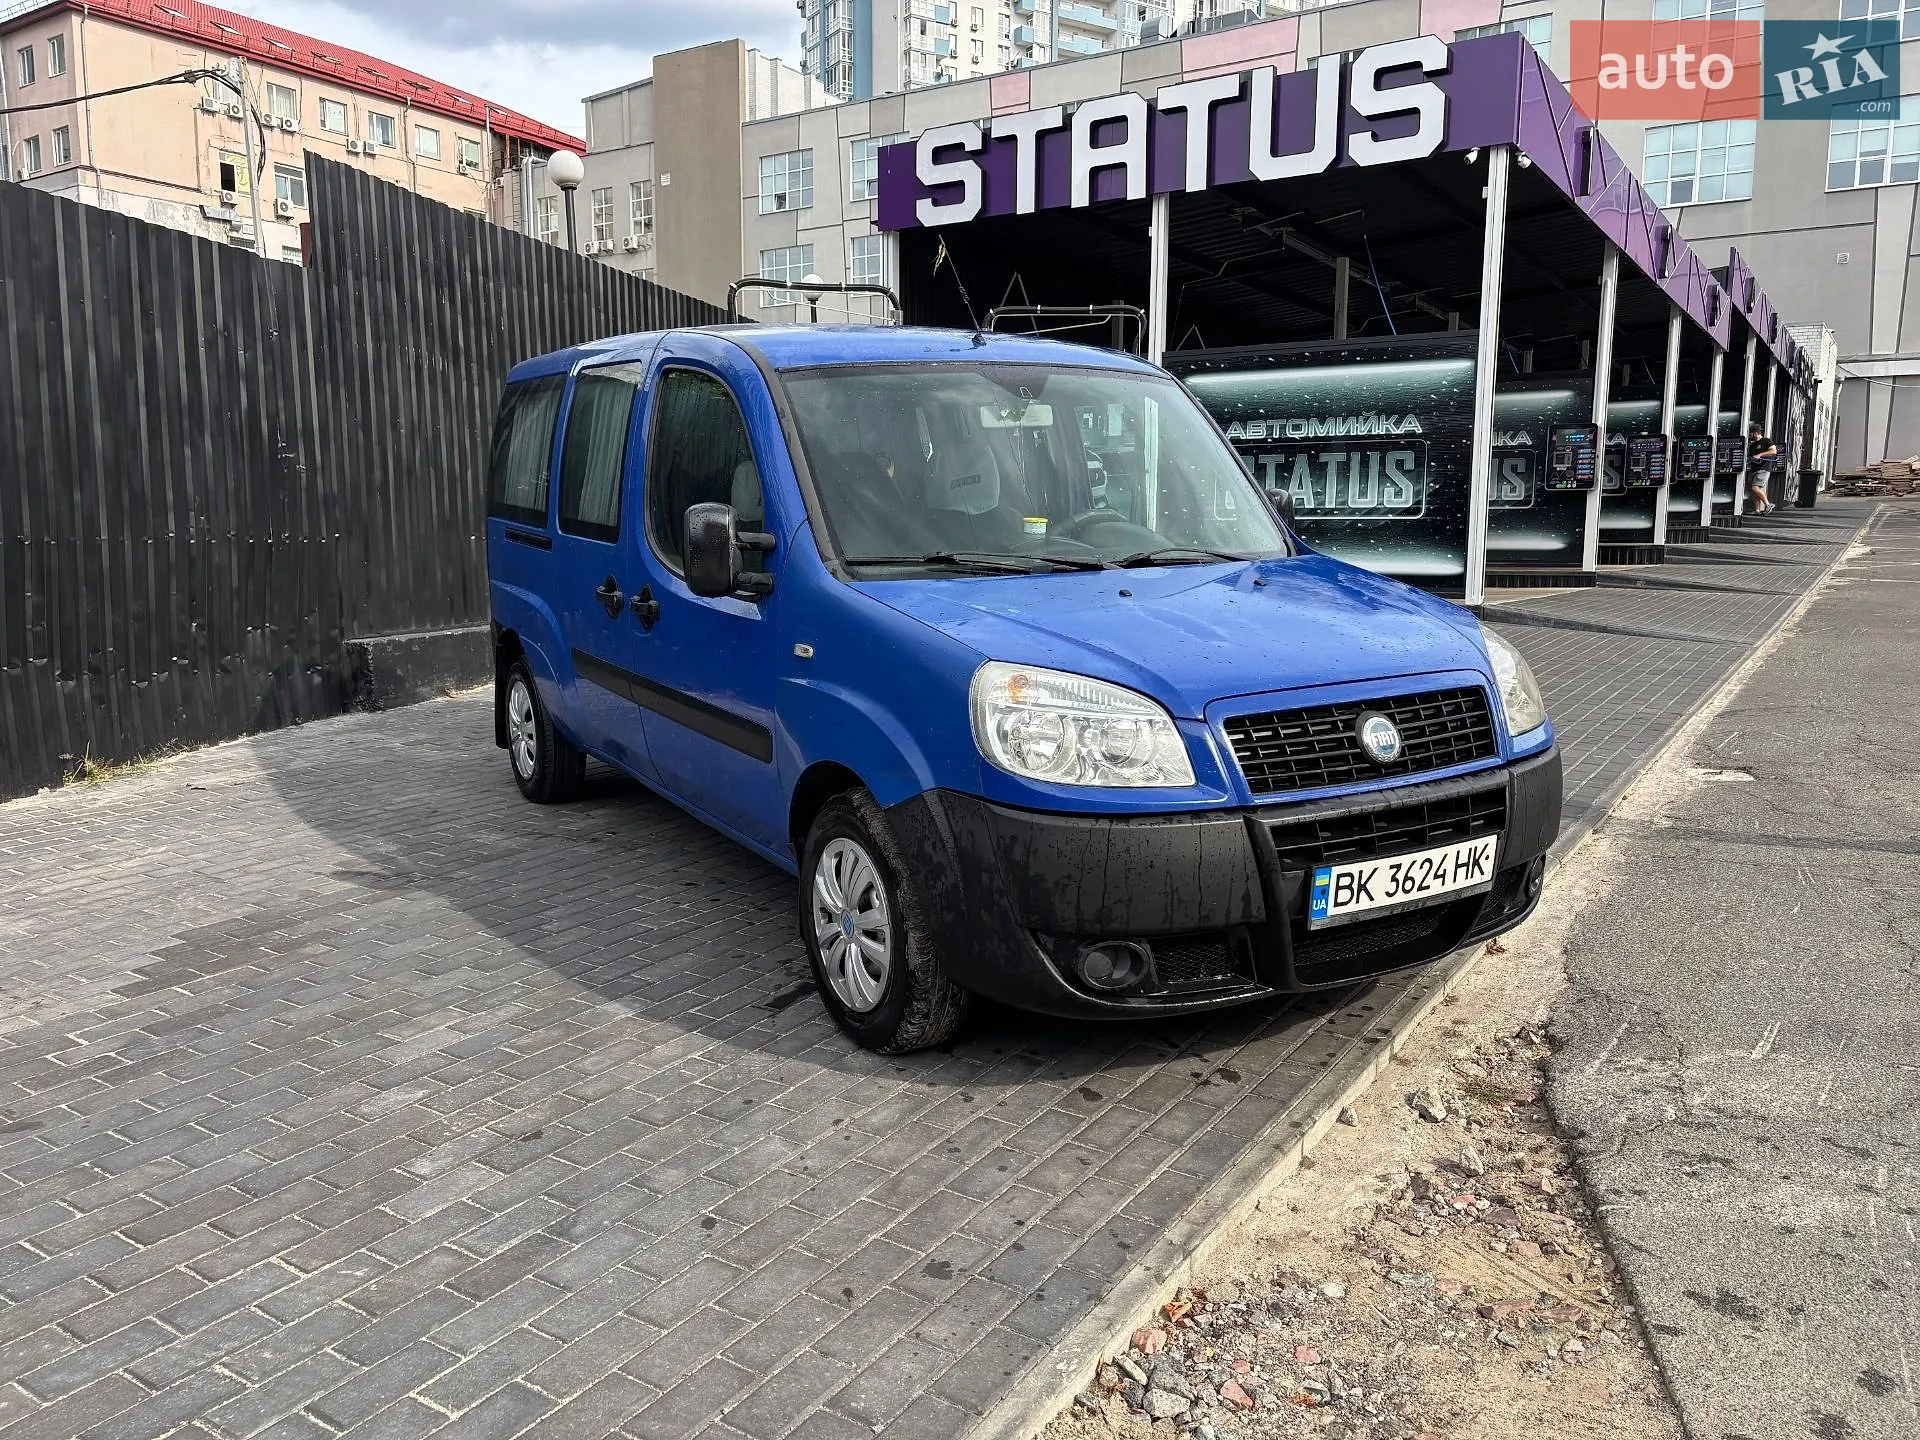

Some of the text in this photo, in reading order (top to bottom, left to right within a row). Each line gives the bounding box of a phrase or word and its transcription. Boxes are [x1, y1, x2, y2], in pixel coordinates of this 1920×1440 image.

[915, 33, 1449, 228] STATUS
[1225, 411, 1423, 440] АВТОМИЙКА
[1371, 730, 1395, 748] FIAT
[1333, 843, 1489, 908] BK 3624 HK
[1313, 899, 1328, 911] UA
